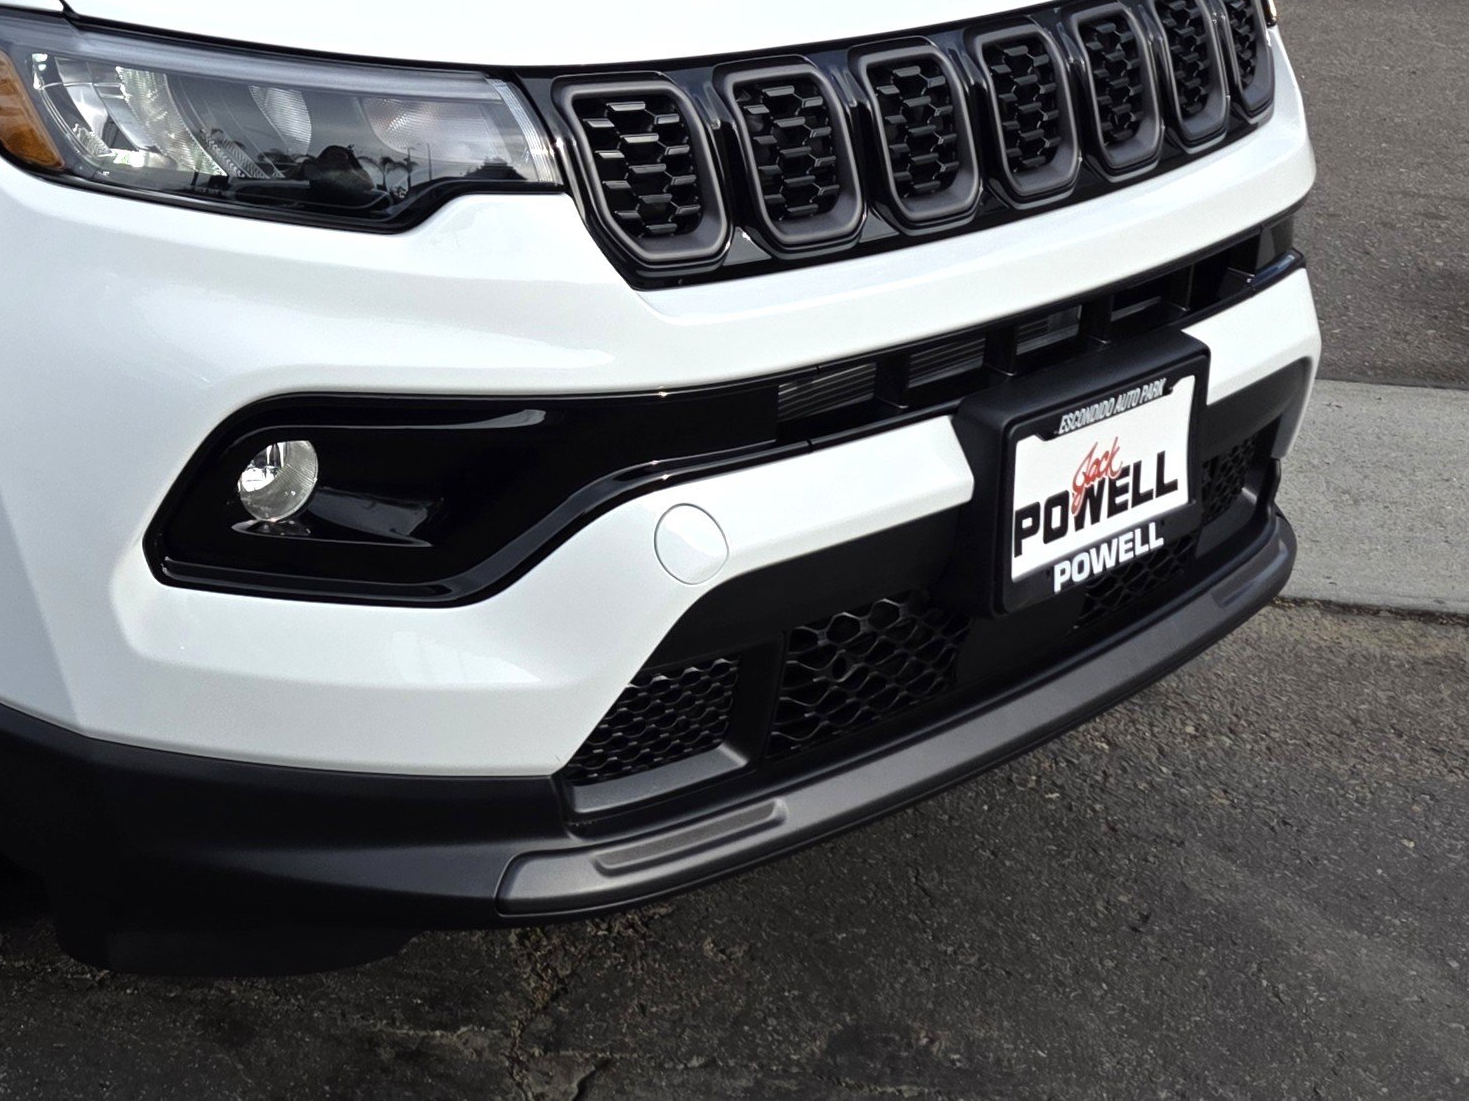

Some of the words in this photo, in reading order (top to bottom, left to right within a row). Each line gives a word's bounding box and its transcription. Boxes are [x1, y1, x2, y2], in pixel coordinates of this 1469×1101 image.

[1058, 397, 1115, 435] ESCONDIDO
[1115, 387, 1142, 416] AUTO
[1140, 378, 1167, 406] PARK
[1014, 450, 1179, 558] POWELL
[1071, 436, 1124, 515] Jack
[1053, 521, 1164, 593] POWELL
